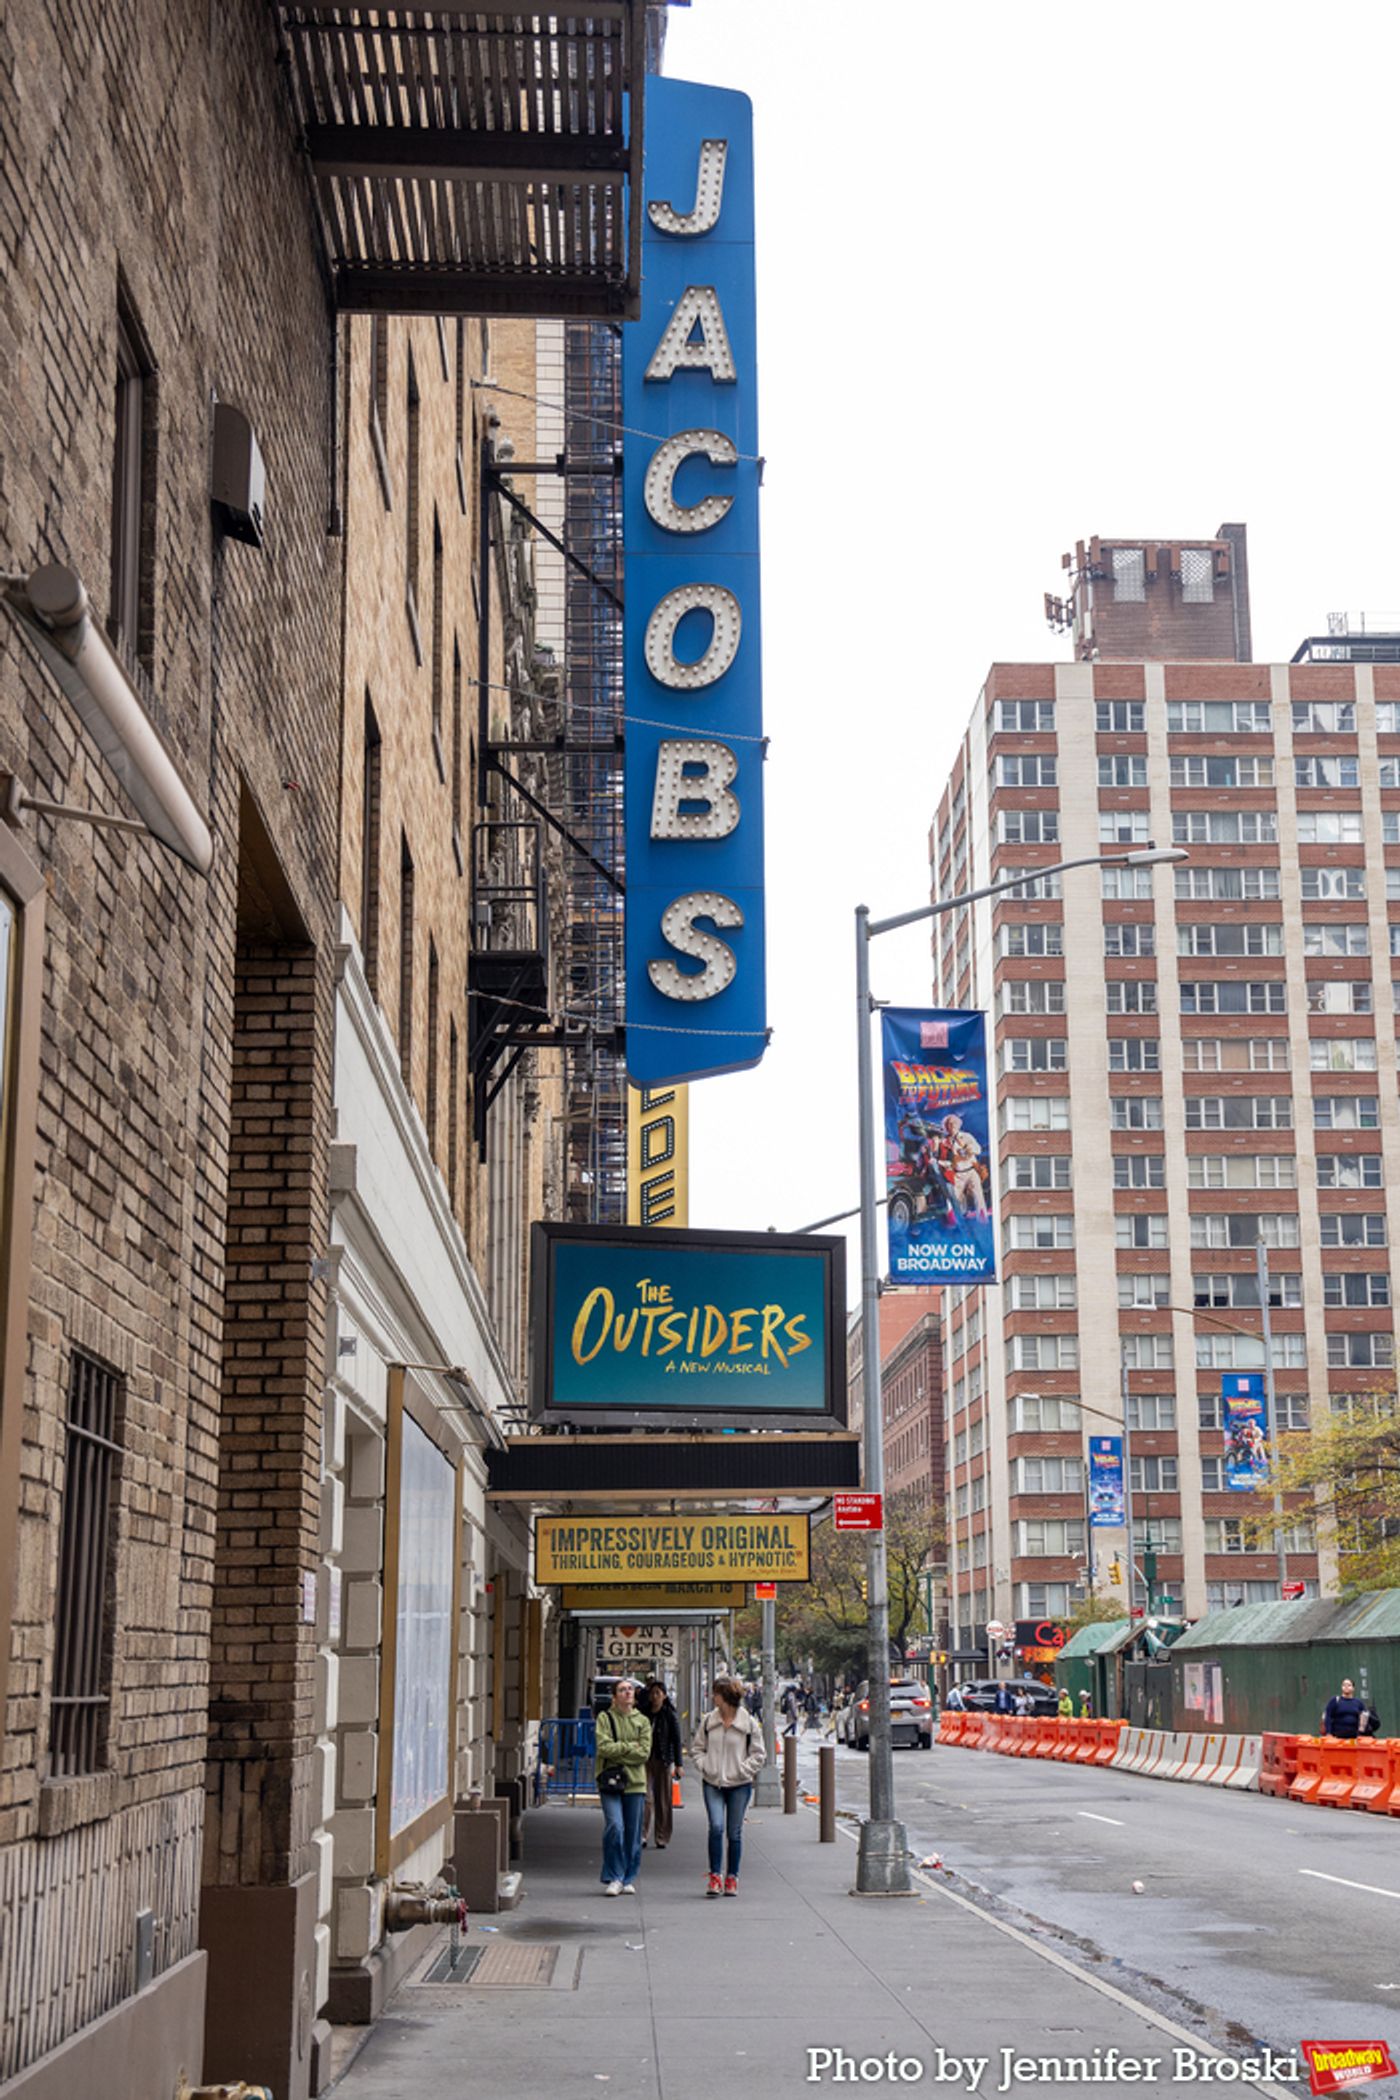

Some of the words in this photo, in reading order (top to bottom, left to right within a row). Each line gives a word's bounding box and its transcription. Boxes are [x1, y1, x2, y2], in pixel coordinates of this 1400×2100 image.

[642, 138, 744, 1004] JACOBS
[908, 1243, 947, 1257] NOW
[951, 1243, 976, 1257] ON
[897, 1257, 988, 1271] BROADWAY
[636, 1278, 674, 1304] THE
[572, 1286, 813, 1369] OUTSIDERS
[665, 1360, 676, 1373] A
[679, 1361, 711, 1374] NEW
[712, 1361, 771, 1375] MUSICAL
[551, 1553, 624, 1570] THRILLING,
[627, 1552, 715, 1569] COURAGEOUS
[718, 1554, 726, 1565] &
[608, 1641, 675, 1657] GIFTS
